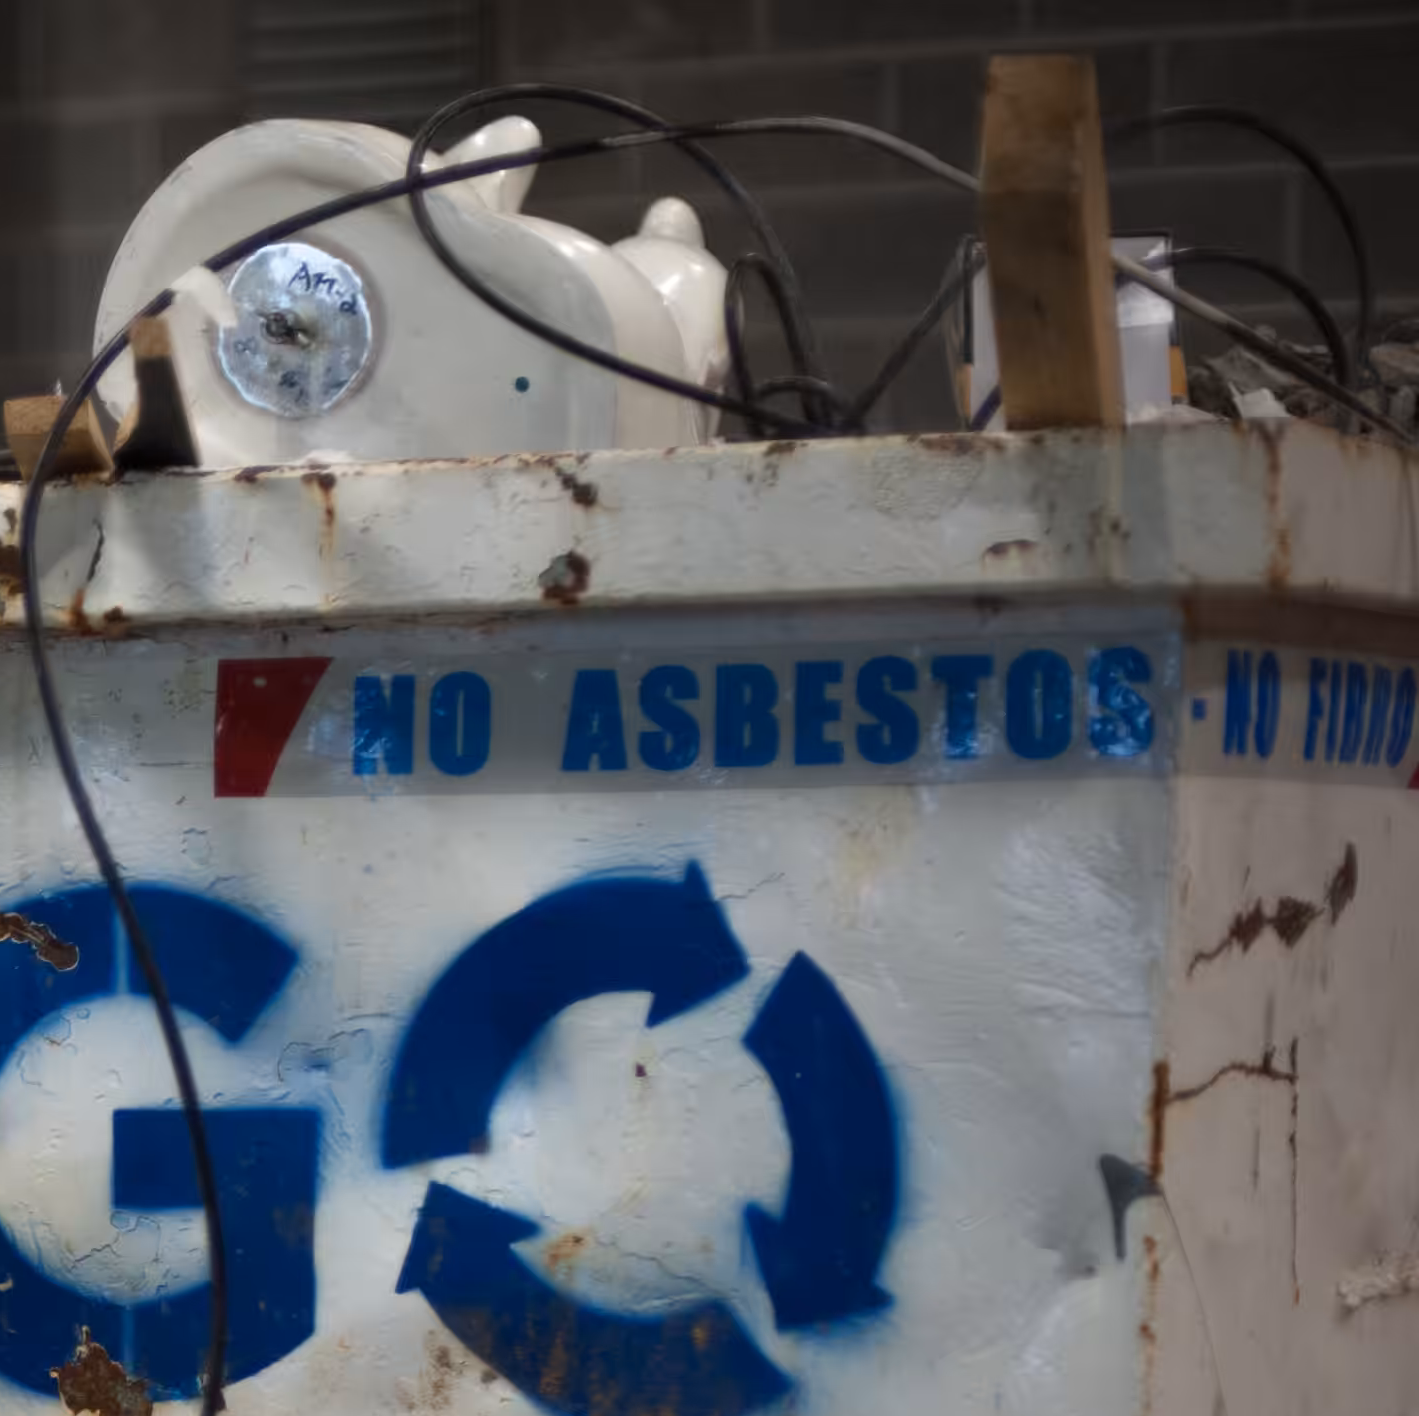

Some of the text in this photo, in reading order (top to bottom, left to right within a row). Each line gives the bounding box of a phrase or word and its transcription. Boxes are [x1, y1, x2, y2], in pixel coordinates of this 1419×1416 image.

[350, 645, 1154, 777] NO ASBESTOS
[1221, 647, 1418, 769] NO FIBRO
